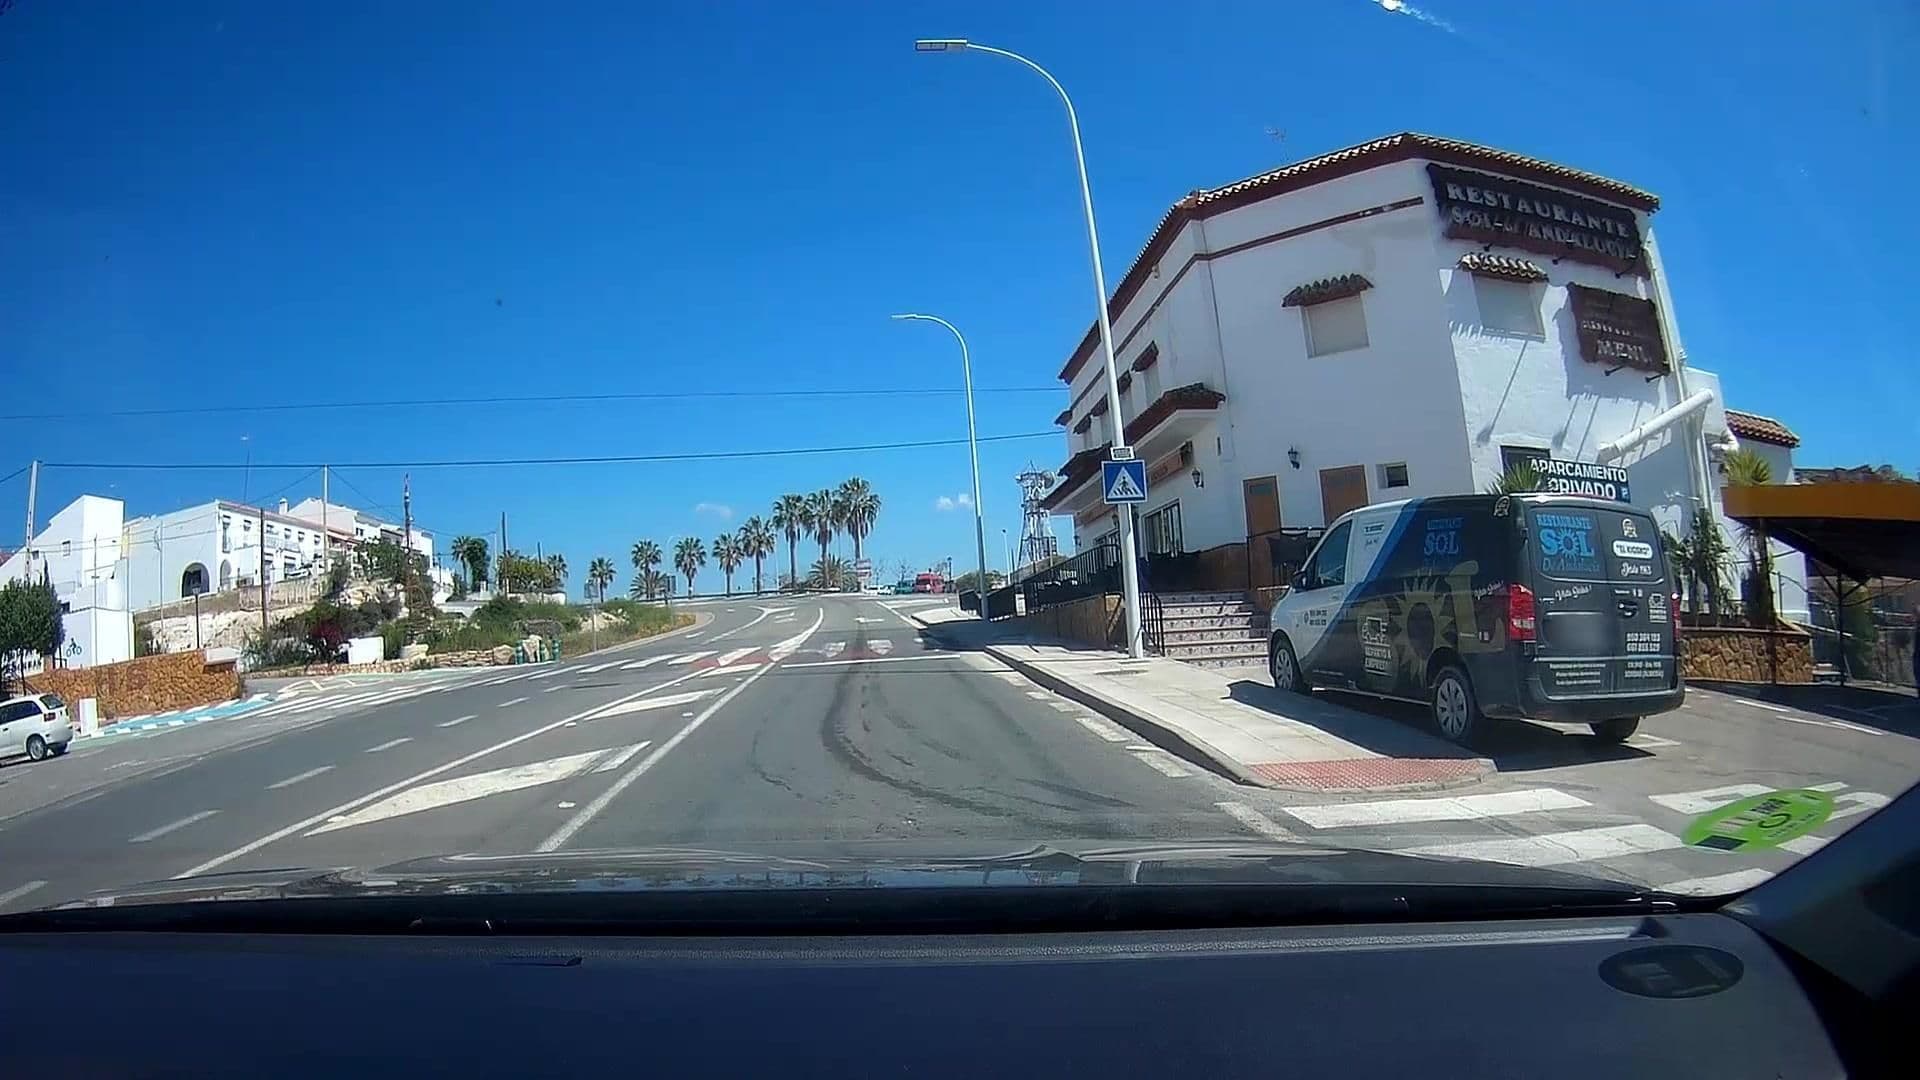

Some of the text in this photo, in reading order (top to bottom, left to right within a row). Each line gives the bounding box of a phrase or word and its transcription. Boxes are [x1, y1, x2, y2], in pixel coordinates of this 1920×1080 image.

[1446, 182, 1629, 239] RESTAURANTE
[1531, 458, 1627, 482] APARCAMIENTO
[1423, 531, 1459, 557] SOL
[1539, 527, 1595, 559] SOL
